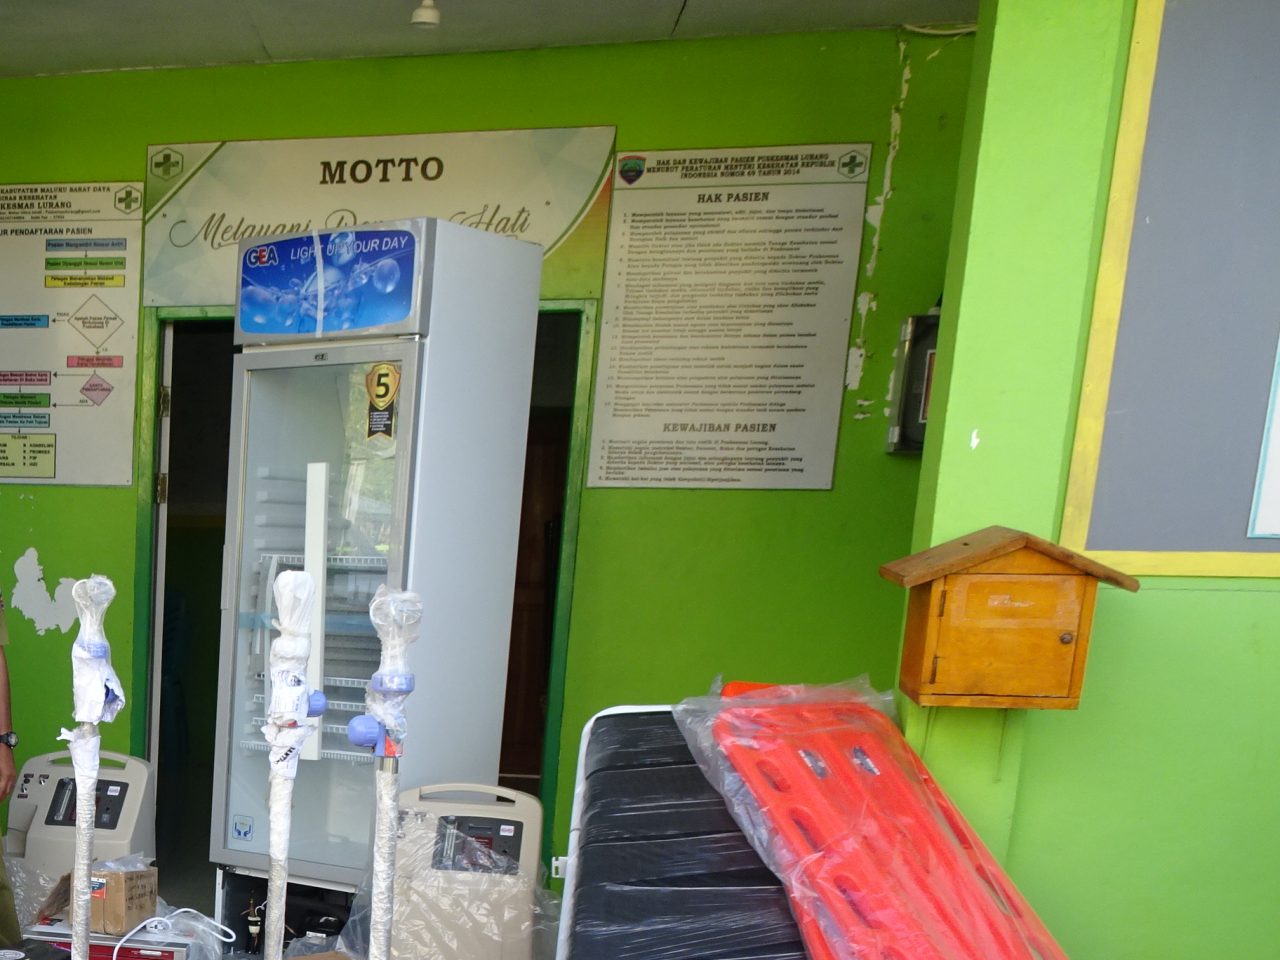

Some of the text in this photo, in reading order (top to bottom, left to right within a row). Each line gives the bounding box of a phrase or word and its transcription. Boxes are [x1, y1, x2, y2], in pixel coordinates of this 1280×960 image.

[320, 156, 445, 185] MOTTO
[38, 201, 72, 209] LURANG
[697, 192, 770, 204] HAK PASIEN
[10, 228, 64, 236] PENDAFTARAN
[246, 246, 279, 267] GEA
[290, 236, 409, 261] LIGH UP YOUR DAY
[375, 373, 390, 399] 5
[683, 423, 797, 433] KEWAJIBAN PASIEN
